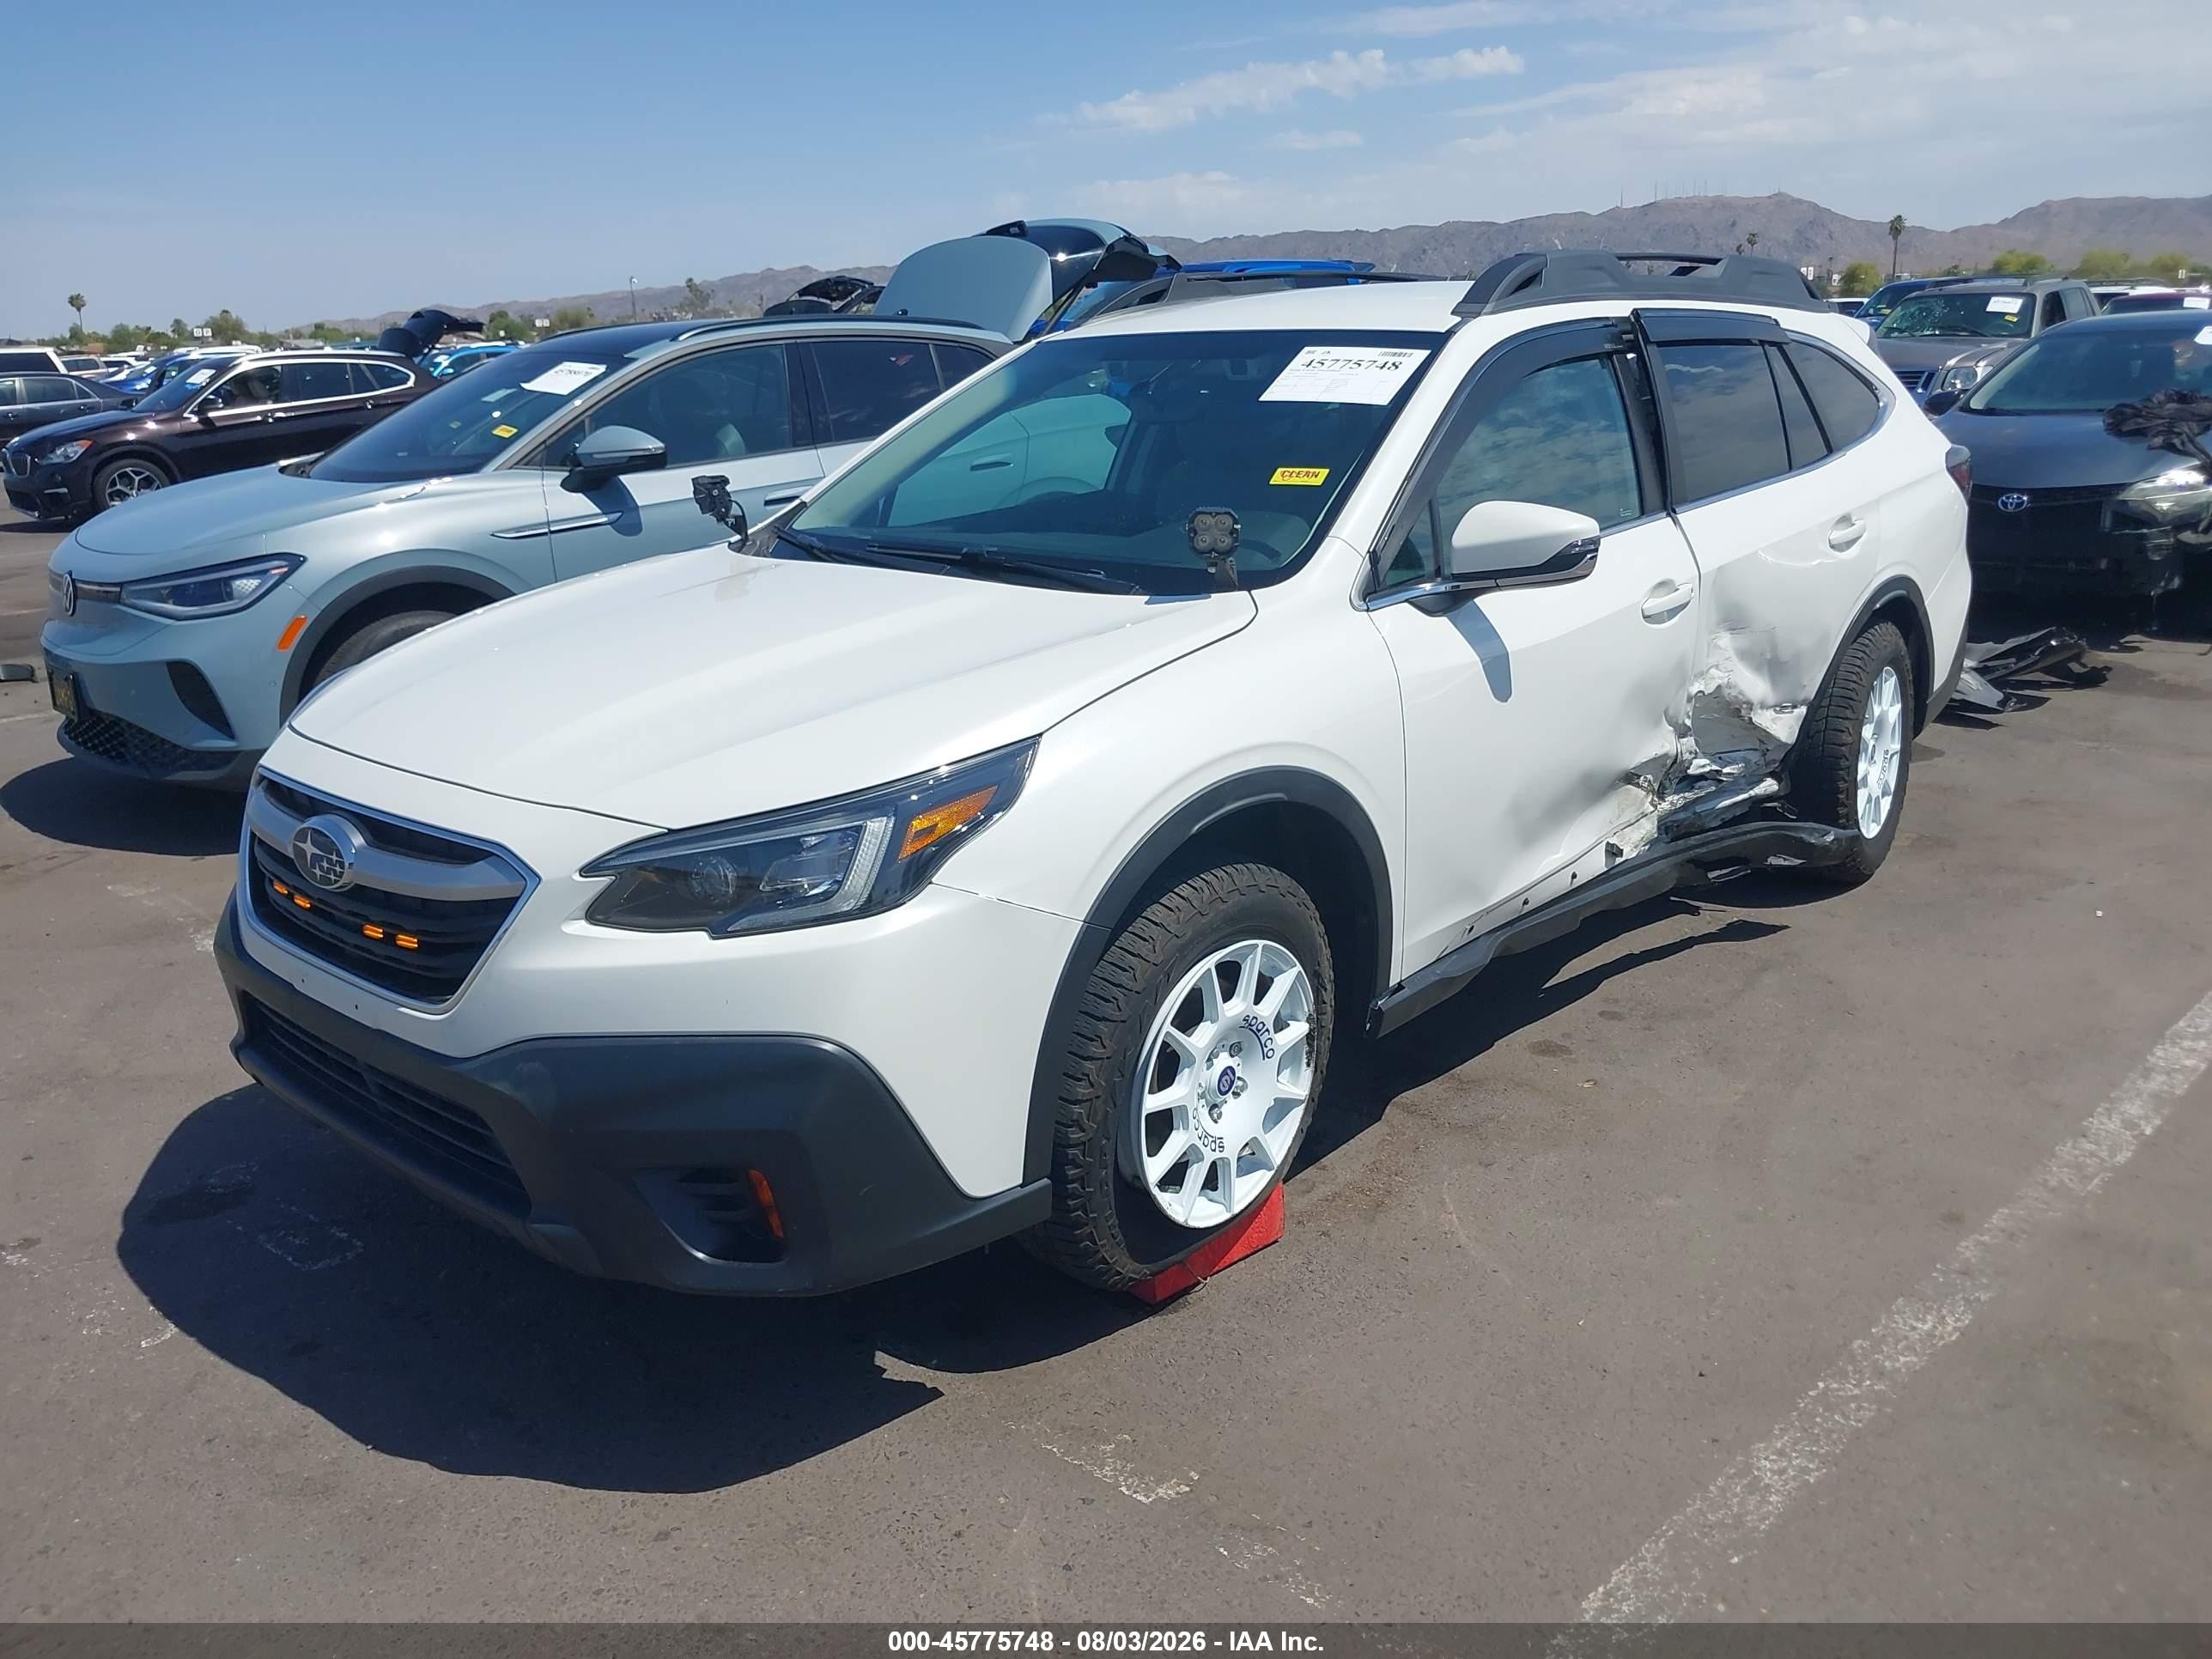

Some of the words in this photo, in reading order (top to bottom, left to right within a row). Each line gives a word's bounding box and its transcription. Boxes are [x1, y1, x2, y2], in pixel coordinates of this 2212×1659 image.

[1301, 358, 1402, 372] 45775748
[1280, 470, 1320, 480] CLEAN
[1242, 1014, 1275, 1060] sparco
